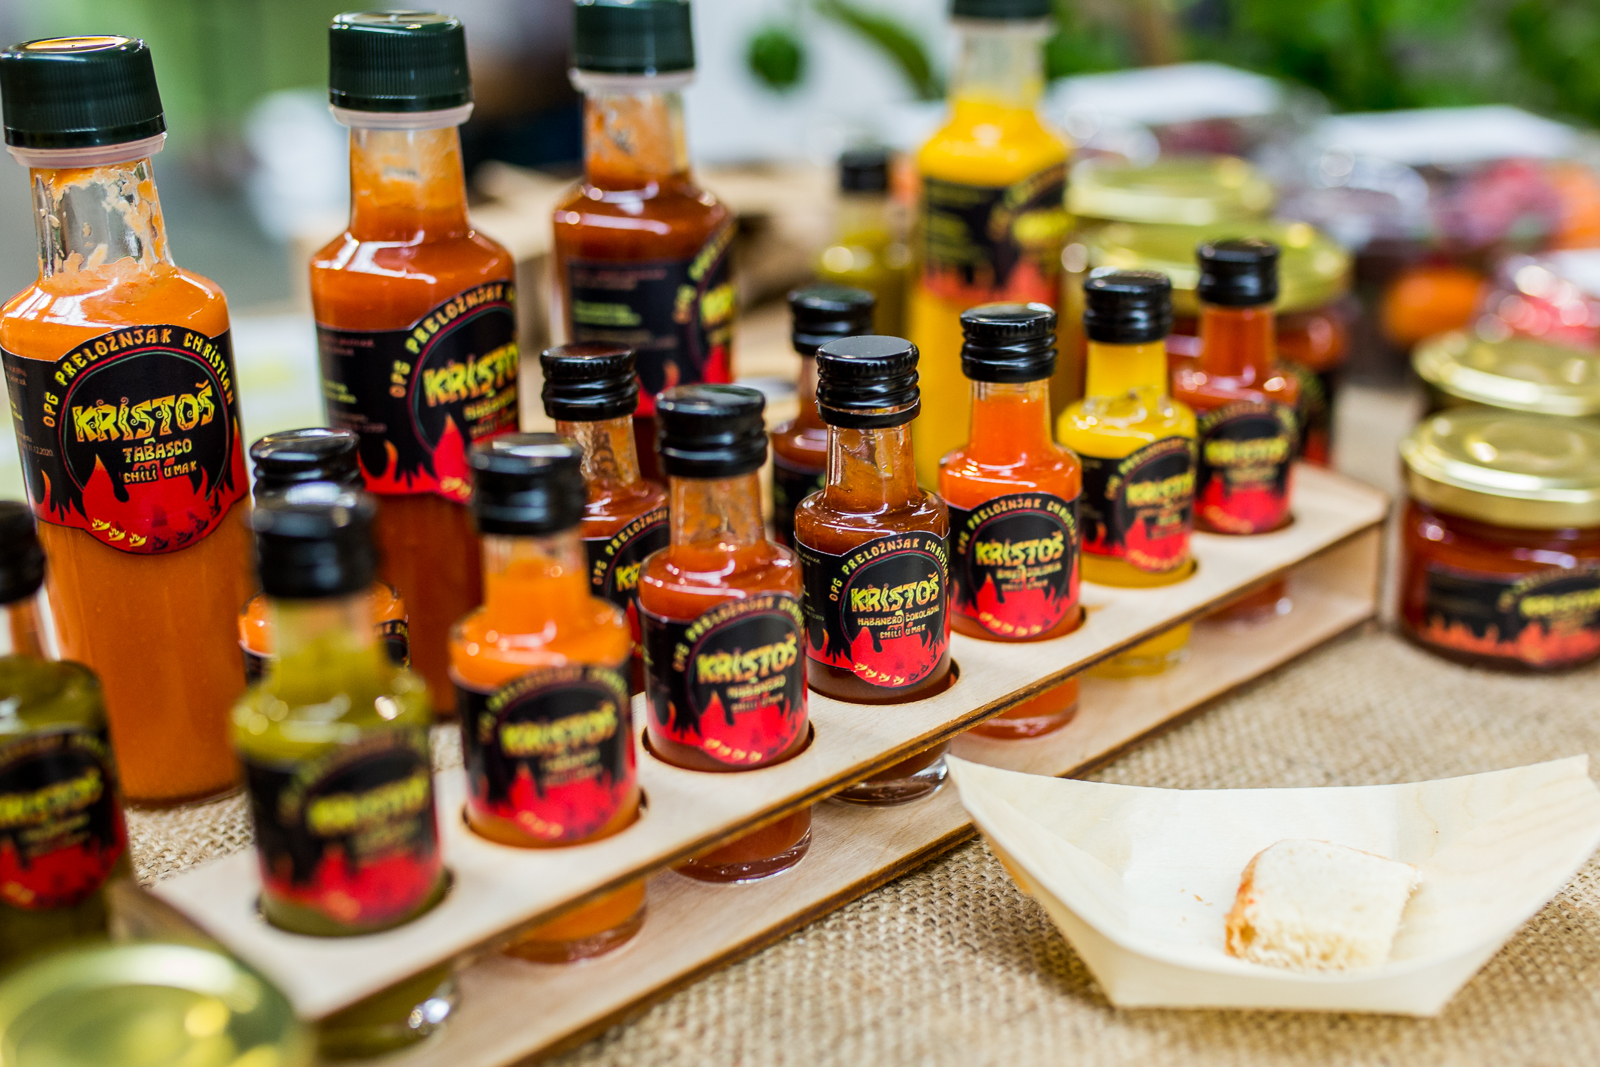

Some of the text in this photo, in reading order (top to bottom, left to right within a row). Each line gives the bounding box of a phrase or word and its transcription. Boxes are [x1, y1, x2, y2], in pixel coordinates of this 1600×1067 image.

[42, 391, 59, 428] OPG
[54, 326, 173, 387] PRELOŽNJAK
[183, 332, 234, 406] CHRISTIAN
[122, 437, 193, 463] TABASCO
[163, 460, 197, 478] UMAK
[829, 577, 843, 602] OPG
[841, 536, 920, 576] PRELOŽNJAK
[857, 615, 903, 627] HABANERO
[905, 623, 926, 636] UMAK
